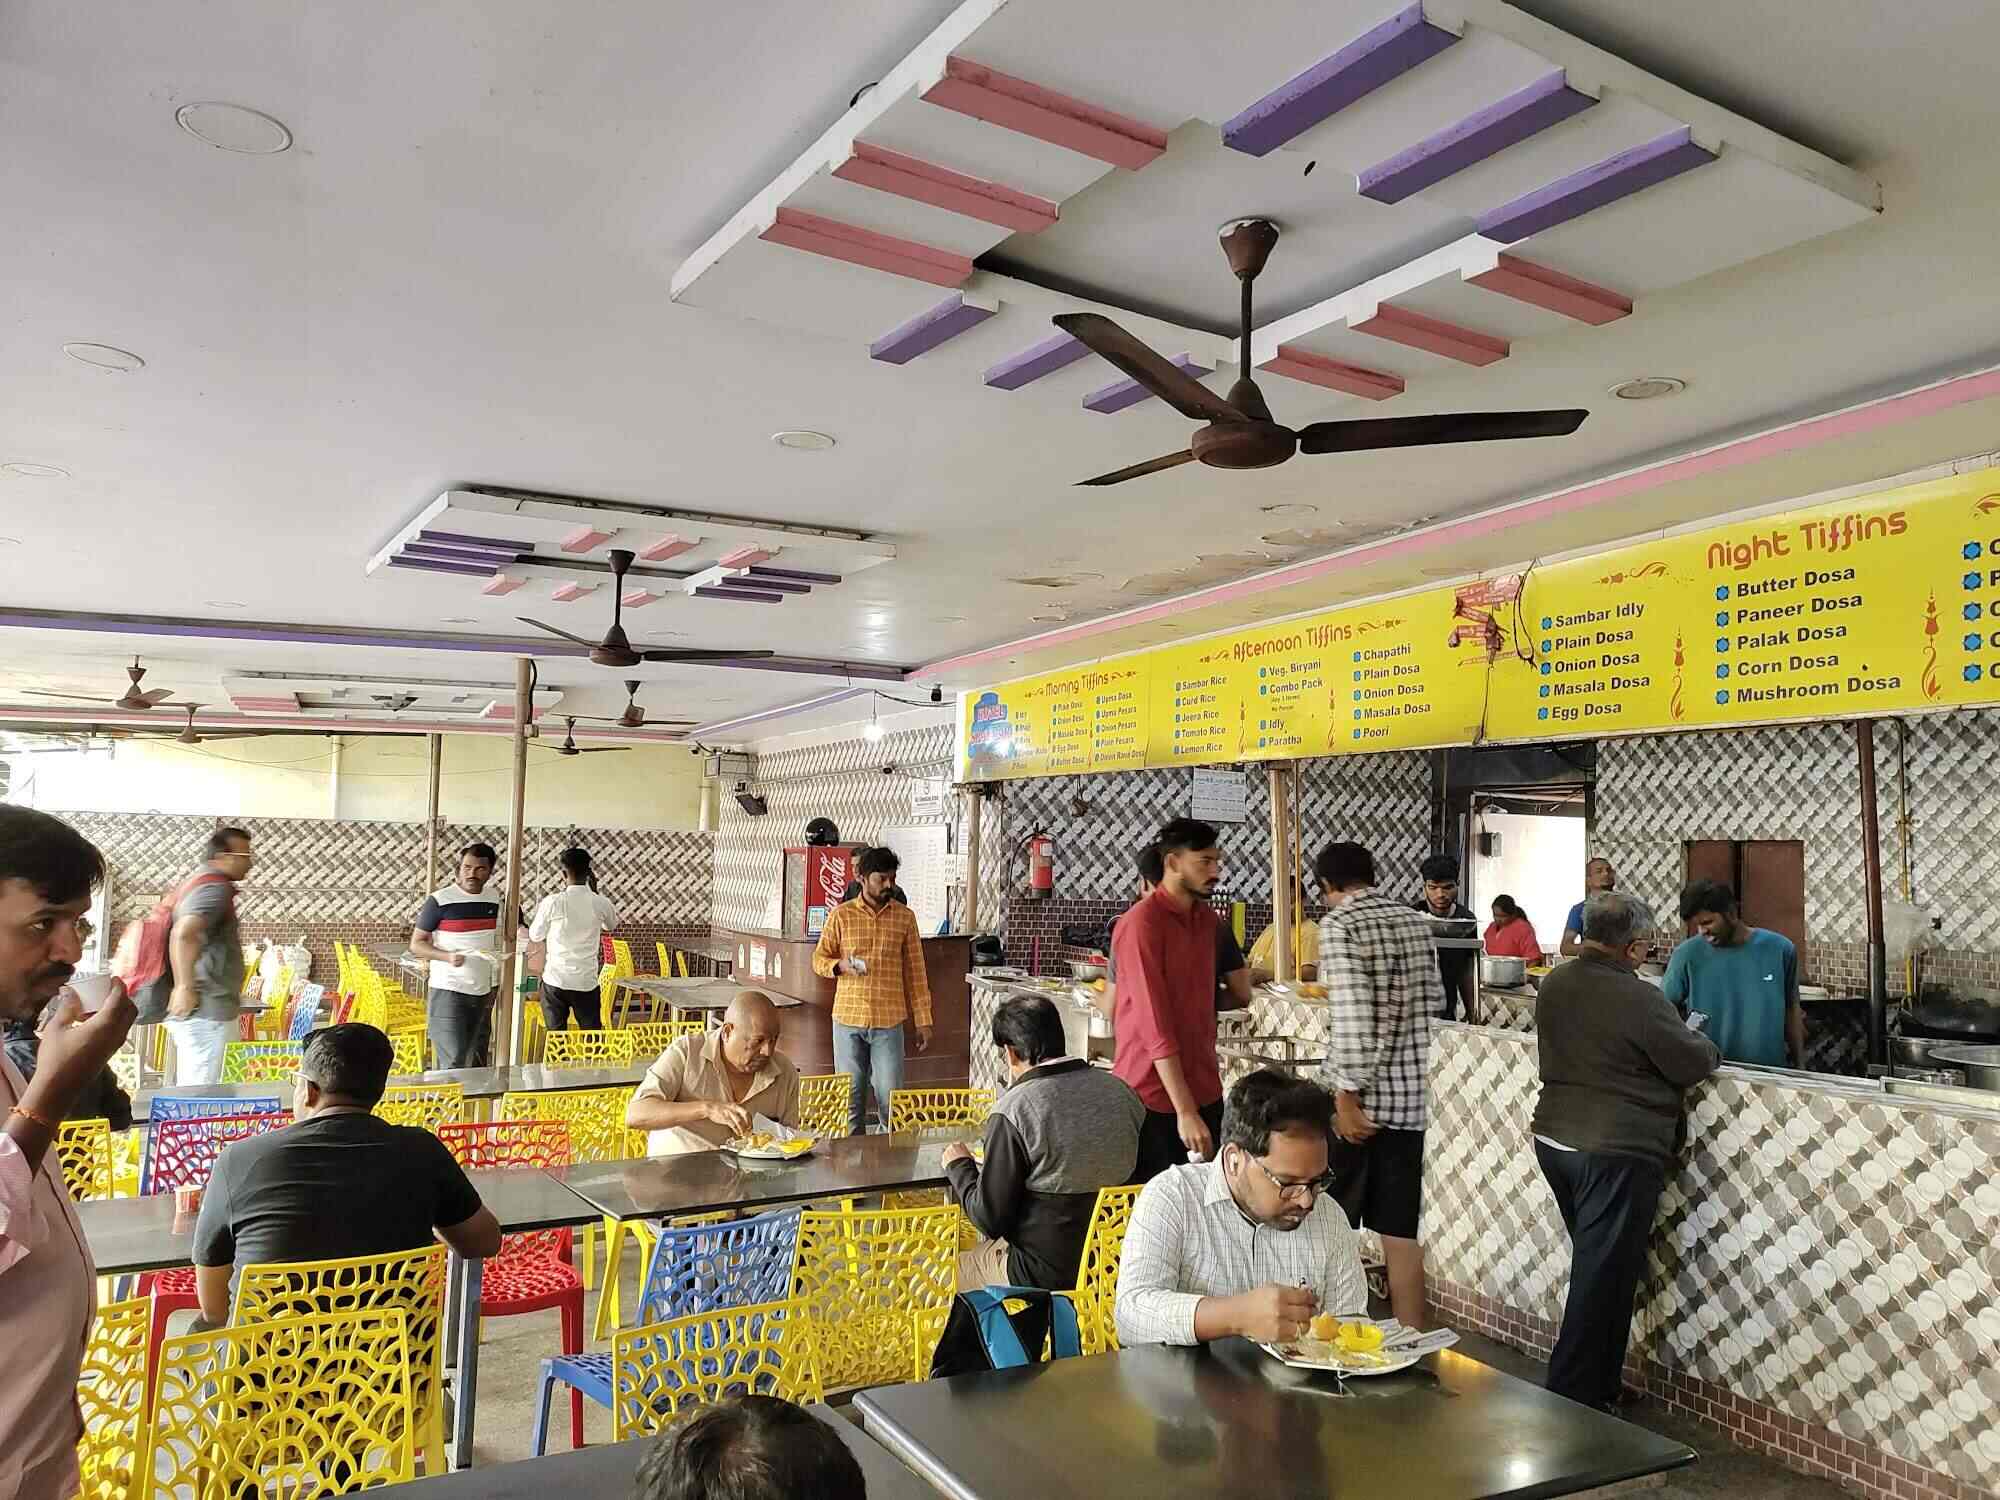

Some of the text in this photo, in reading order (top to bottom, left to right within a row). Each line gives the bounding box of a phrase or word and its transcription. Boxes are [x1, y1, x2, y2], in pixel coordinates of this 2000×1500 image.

[1708, 512, 1908, 570] Night Tiffins
[1737, 568, 1855, 597] Butter Dosa
[1556, 602, 1644, 628] Sambar Idly
[1737, 594, 1862, 623] Paneer Dosa
[1234, 624, 1352, 662] Afternoon Tiffins
[1556, 630, 1633, 650] Plain Dosa
[1738, 625, 1847, 649] Palak Dosa
[1364, 644, 1411, 660] Chapathi
[1269, 658, 1320, 677] Veg. Biryani
[1555, 653, 1640, 673] Onion Dosa
[1738, 655, 1839, 676] Corn Dosa
[1364, 664, 1420, 680] Plain Dosa
[1046, 673, 1108, 696] Morning Tiffins
[1182, 676, 1226, 690] Sambar Rice
[1270, 678, 1322, 694] Combo Pack
[1554, 676, 1650, 696] Masala Dosa
[1738, 676, 1900, 702] Mushroom Dosa
[1182, 694, 1216, 706] Curd Rice
[1364, 684, 1424, 700] Onion Dosa
[1182, 710, 1219, 722] Jeera Rice
[1364, 703, 1430, 720] Masala Dosa
[1552, 703, 1622, 720] Egg Dosa
[1182, 726, 1226, 738] Tomato Rice
[1269, 720, 1284, 731] Idly
[1364, 726, 1389, 738] Poori
[1181, 744, 1222, 754] Lemon Rice
[1269, 736, 1302, 746] Paratha
